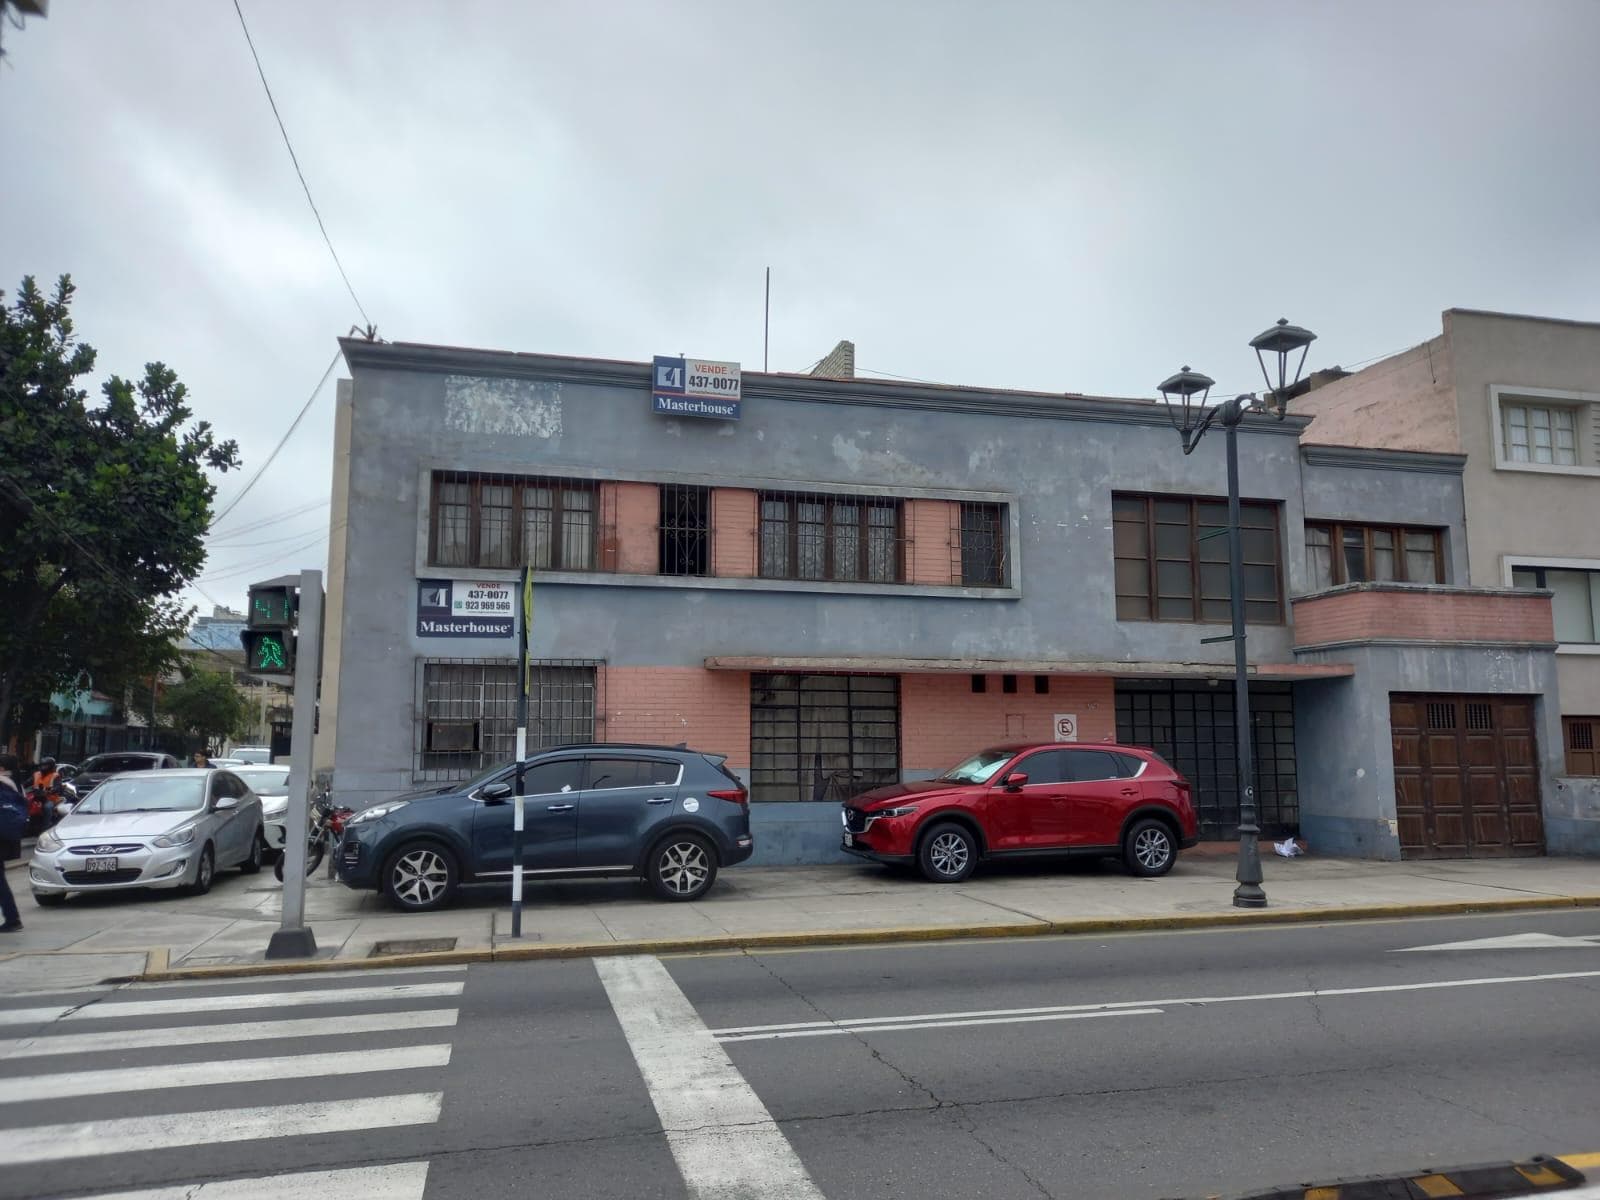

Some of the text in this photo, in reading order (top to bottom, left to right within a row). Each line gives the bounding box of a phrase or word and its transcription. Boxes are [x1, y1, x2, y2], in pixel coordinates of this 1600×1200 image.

[695, 364, 728, 374] VENDE
[688, 375, 739, 390] 437-0077
[658, 397, 735, 415] Masterhouse
[467, 590, 509, 599] 437-0077
[465, 601, 510, 610] 923 969 566
[420, 621, 508, 633] Masterhouse
